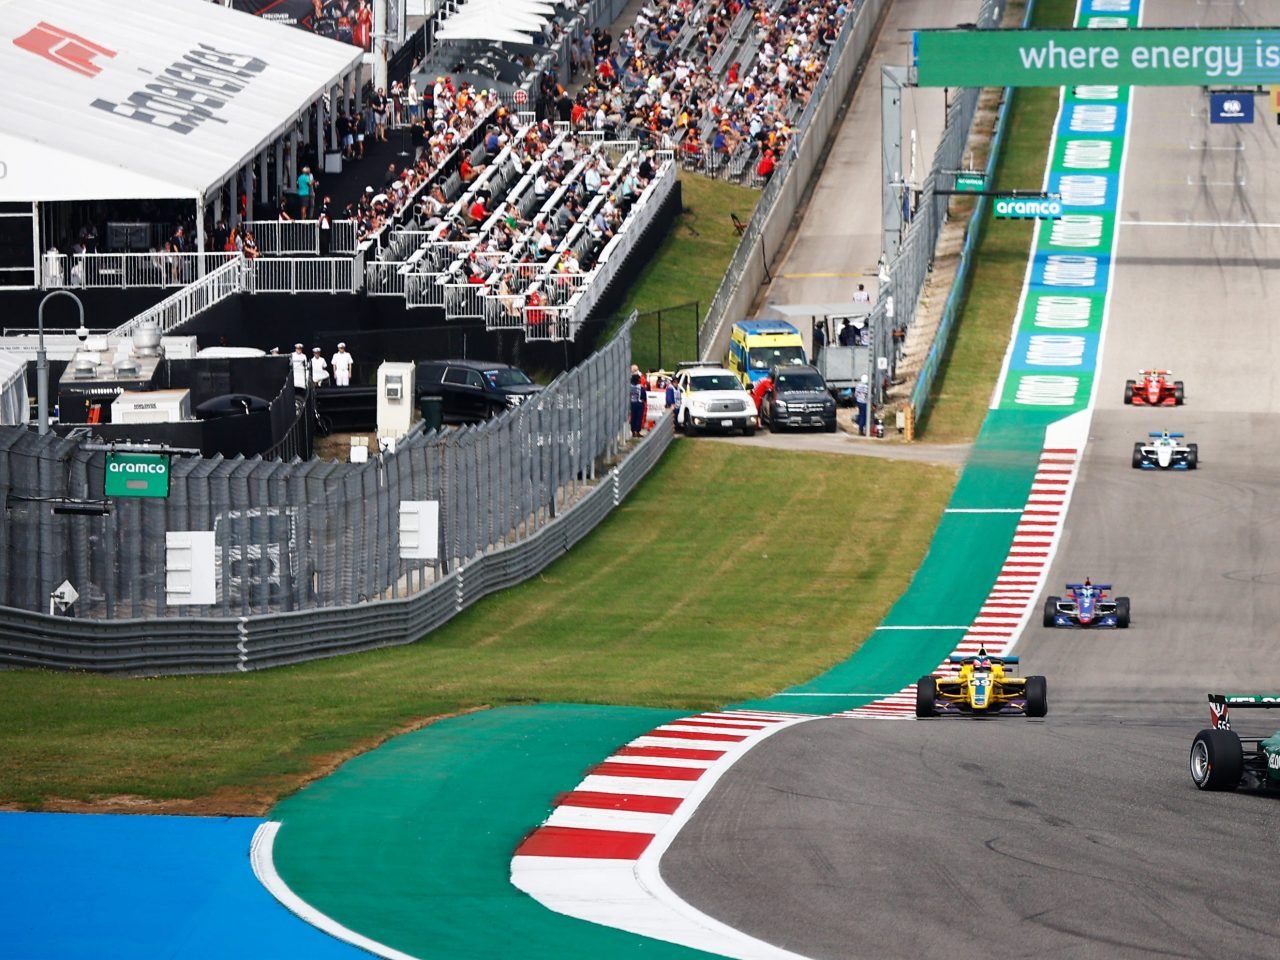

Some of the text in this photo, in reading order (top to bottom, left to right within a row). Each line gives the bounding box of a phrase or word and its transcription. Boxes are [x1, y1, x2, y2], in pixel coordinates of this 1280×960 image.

[1019, 40, 1120, 69] where
[1131, 46, 1244, 77] energy
[1256, 39, 1280, 68] is
[996, 202, 1061, 215] aramco
[110, 462, 166, 474] aramco
[971, 678, 991, 687] 49
